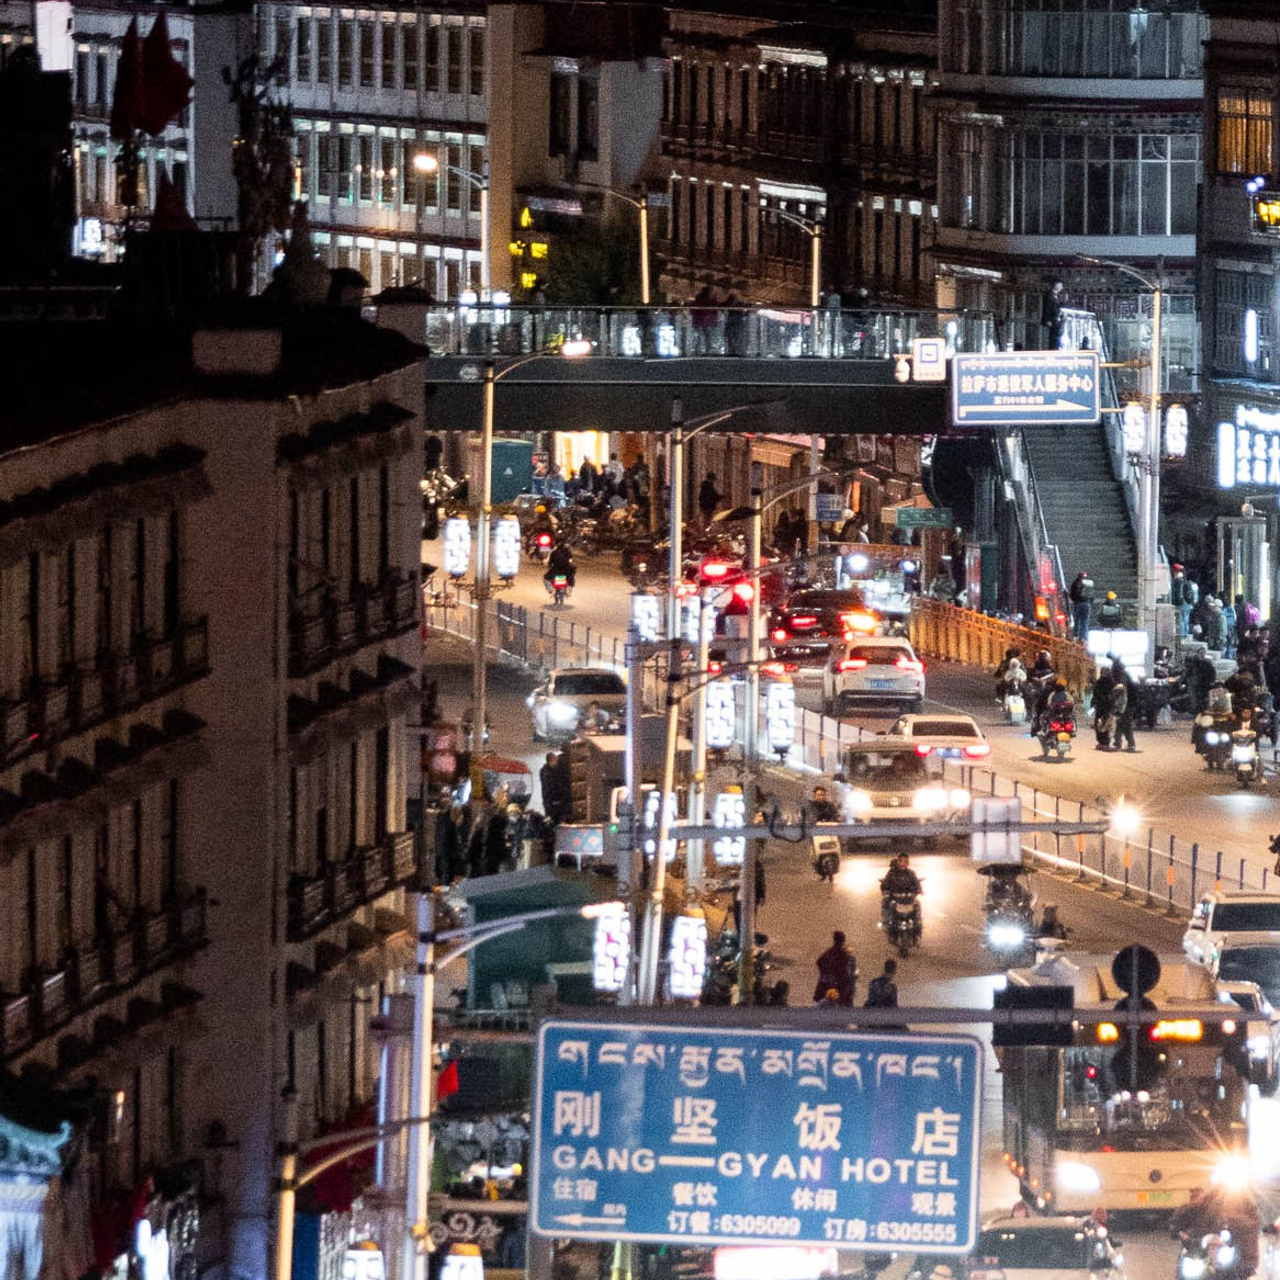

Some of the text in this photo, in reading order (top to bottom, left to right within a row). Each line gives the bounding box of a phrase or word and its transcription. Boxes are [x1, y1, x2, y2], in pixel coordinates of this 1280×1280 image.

[553, 1091, 960, 1157] 刚坚饭店
[842, 1157, 959, 1186] HOTEL
[553, 1176, 957, 1216] 住宿 餐饮 休闲 观景
